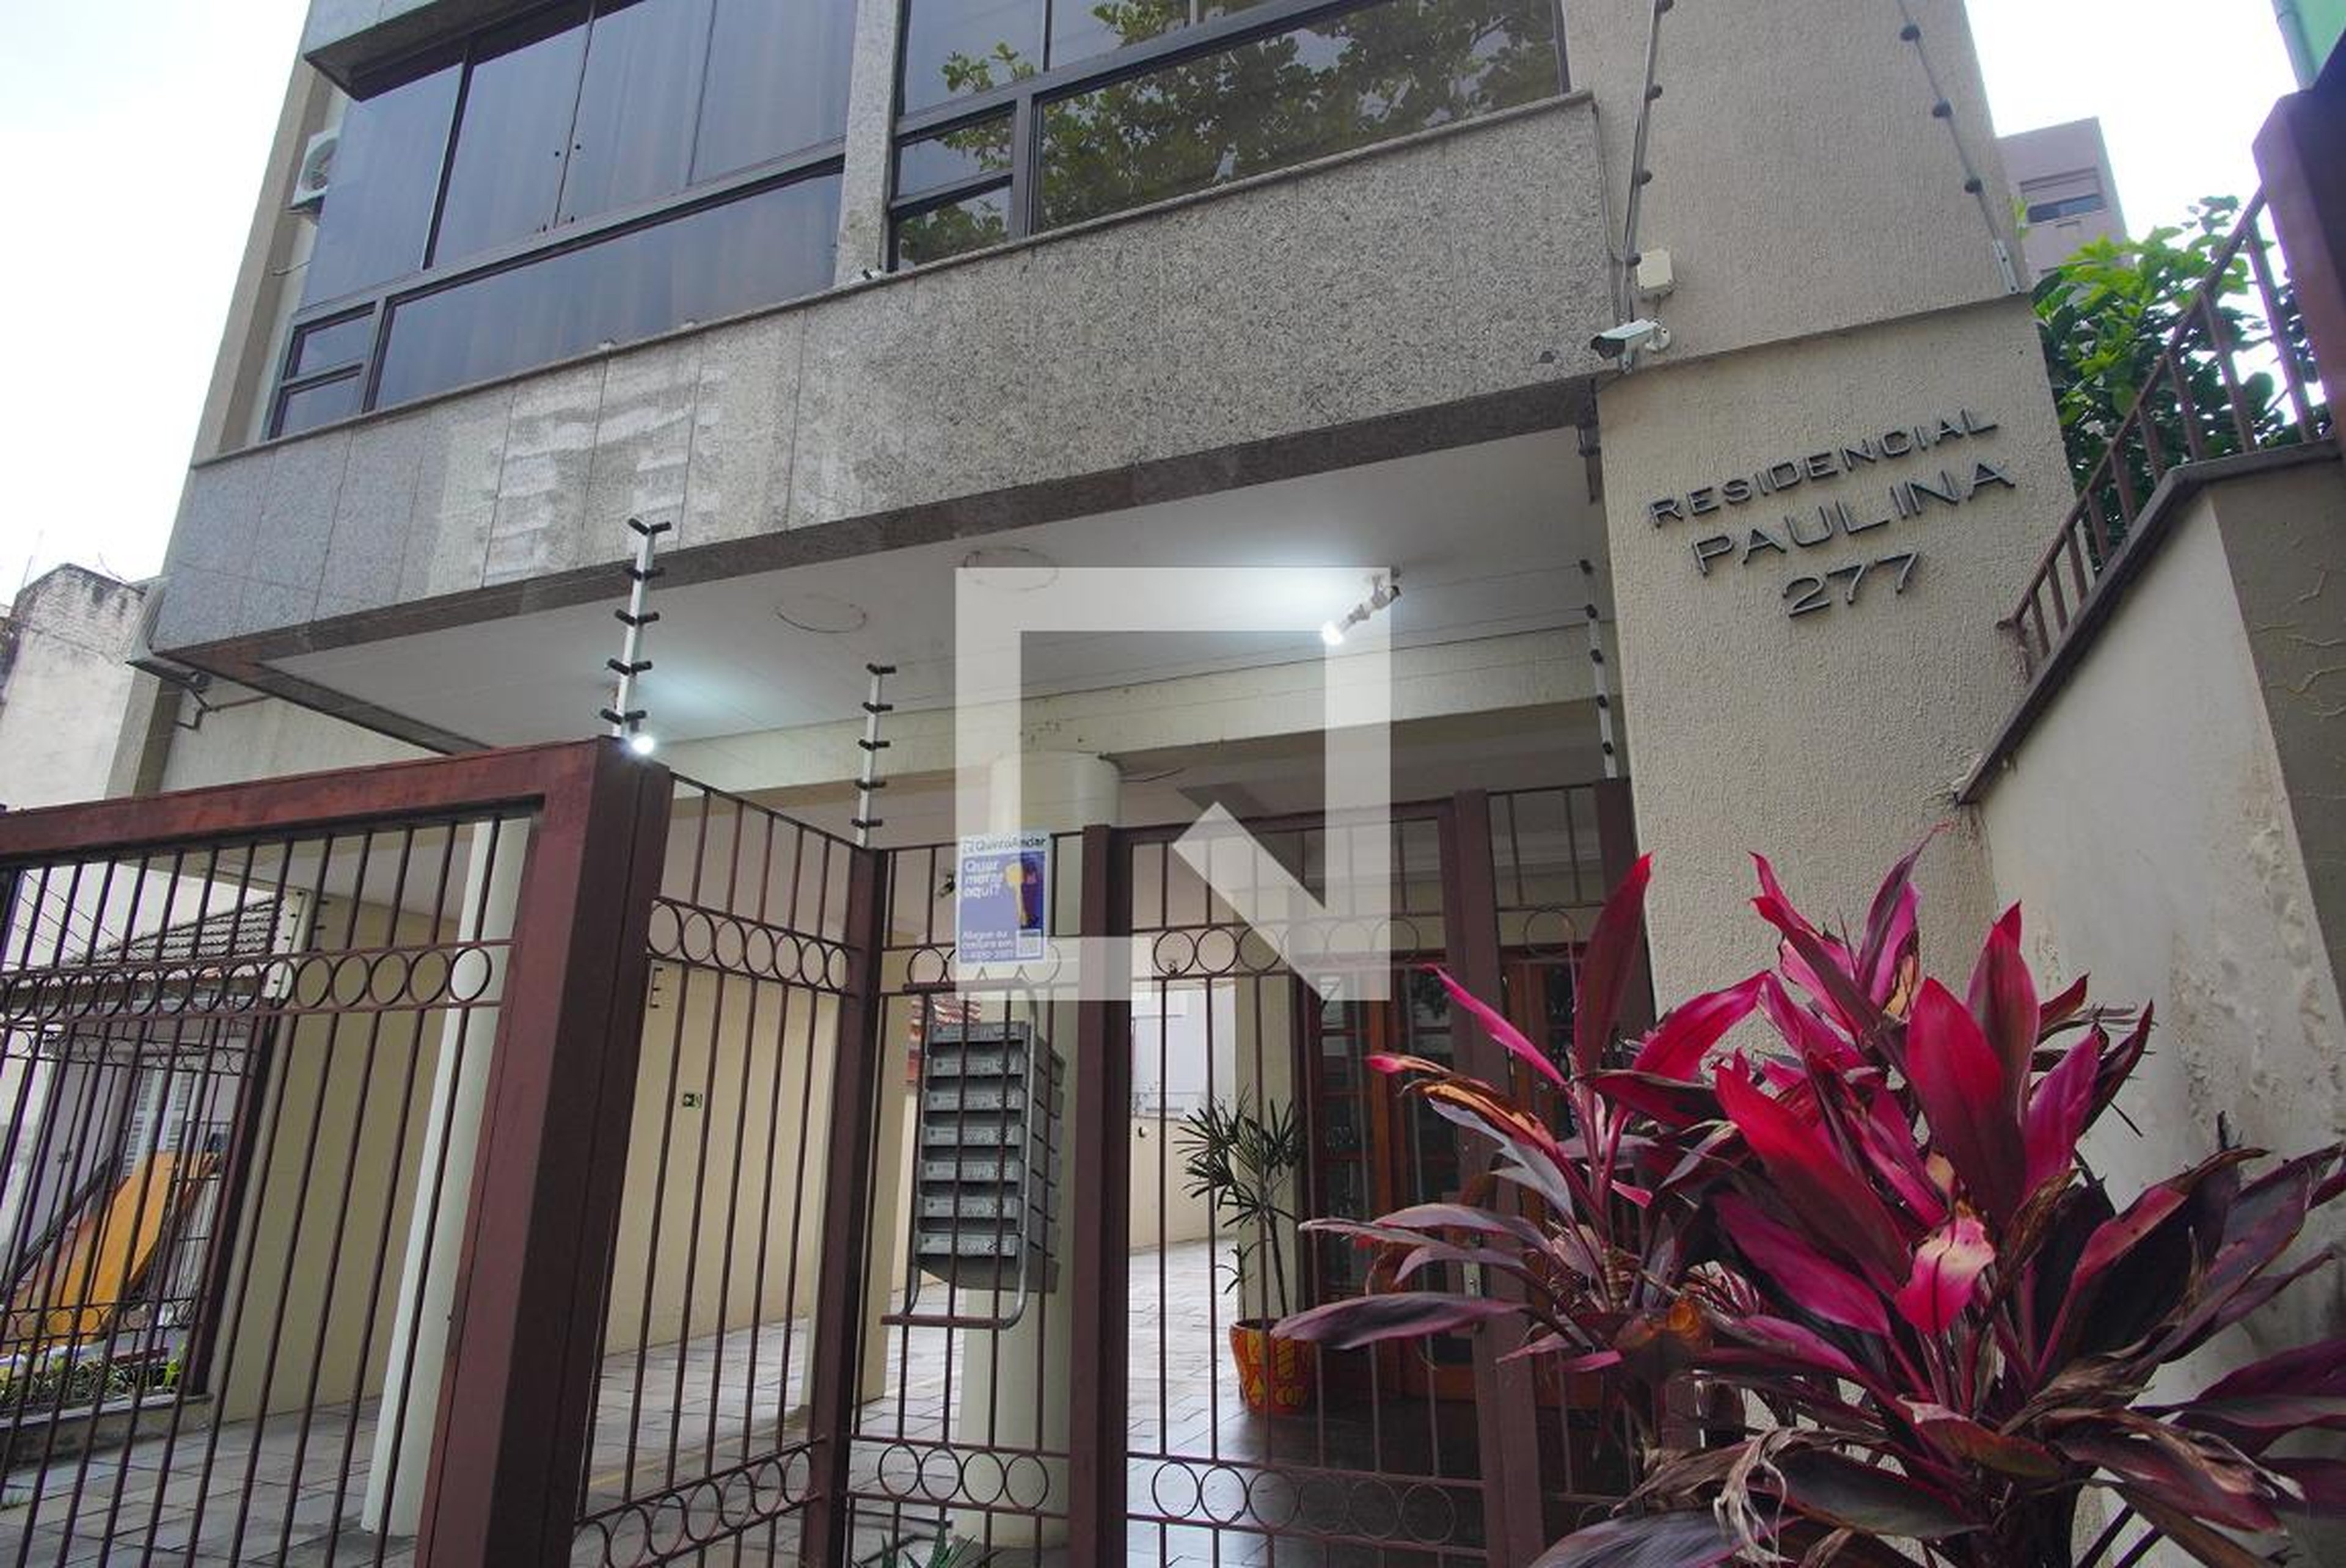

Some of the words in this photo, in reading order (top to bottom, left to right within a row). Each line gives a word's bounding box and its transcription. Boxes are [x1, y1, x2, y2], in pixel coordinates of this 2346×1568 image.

[1650, 408, 1998, 530] RESIDENCIAL
[1692, 462, 2016, 578] PAULINA
[1781, 551, 1921, 618] 277
